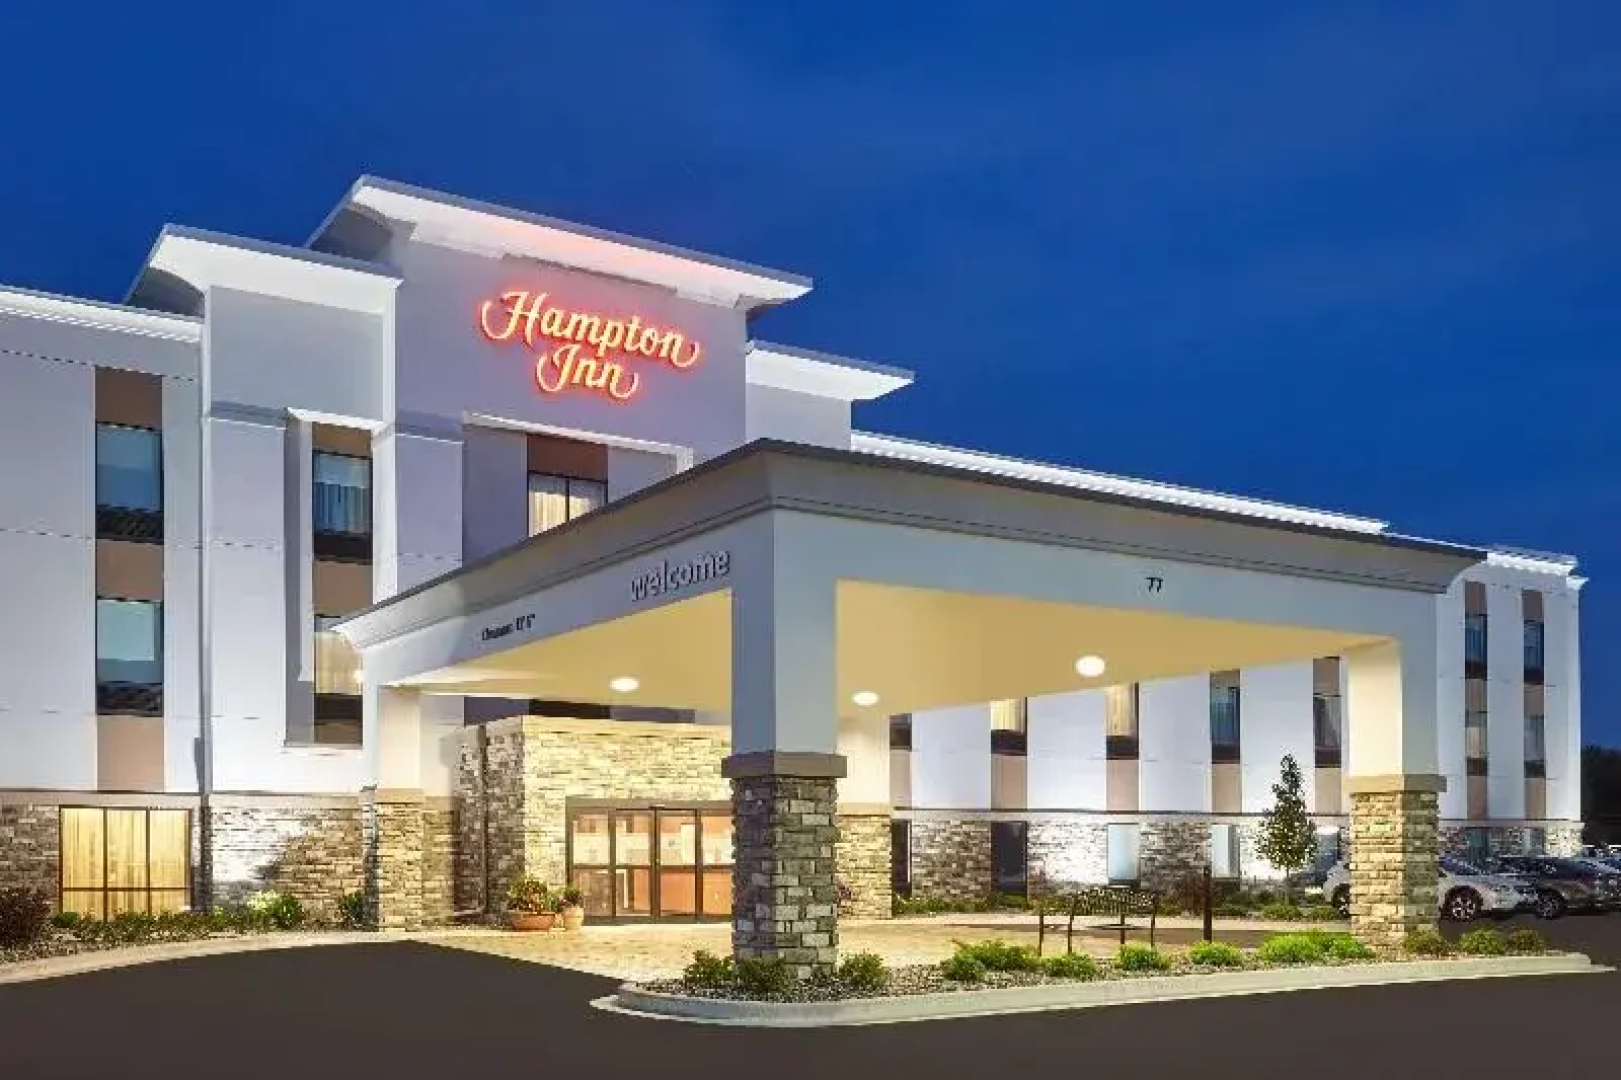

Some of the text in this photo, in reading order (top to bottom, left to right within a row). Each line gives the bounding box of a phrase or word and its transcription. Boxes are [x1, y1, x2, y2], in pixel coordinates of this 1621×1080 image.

[480, 290, 700, 369] Hampton
[535, 343, 640, 399] Inn
[630, 550, 731, 602] welcome
[1146, 576, 1164, 593] 77
